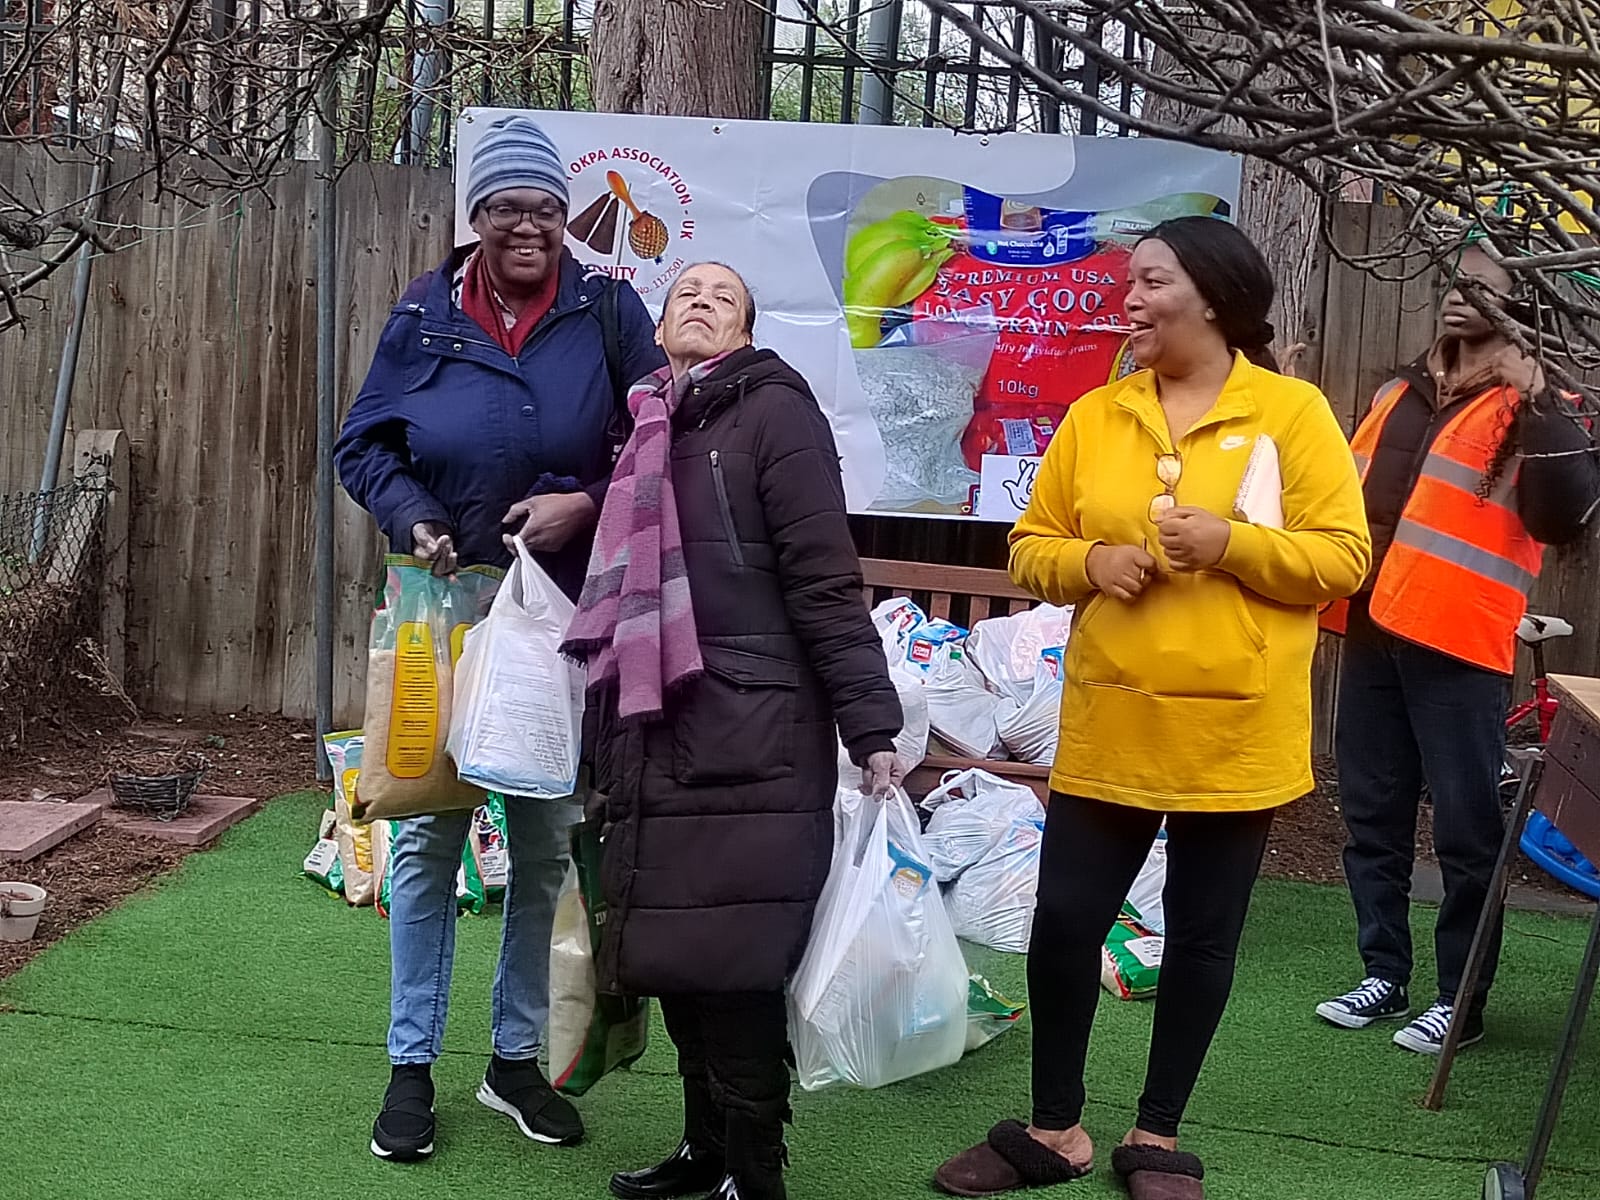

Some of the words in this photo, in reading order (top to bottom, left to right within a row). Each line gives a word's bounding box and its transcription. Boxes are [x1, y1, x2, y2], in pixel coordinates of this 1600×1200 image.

[570, 150, 608, 173] OKPA
[611, 147, 692, 205] ASSOCIATION
[680, 220, 695, 240] UK
[652, 258, 685, 288] 1127501
[953, 269, 1060, 285] PREMIUM
[1071, 269, 1116, 285] USA
[997, 379, 1039, 398] 10kg
